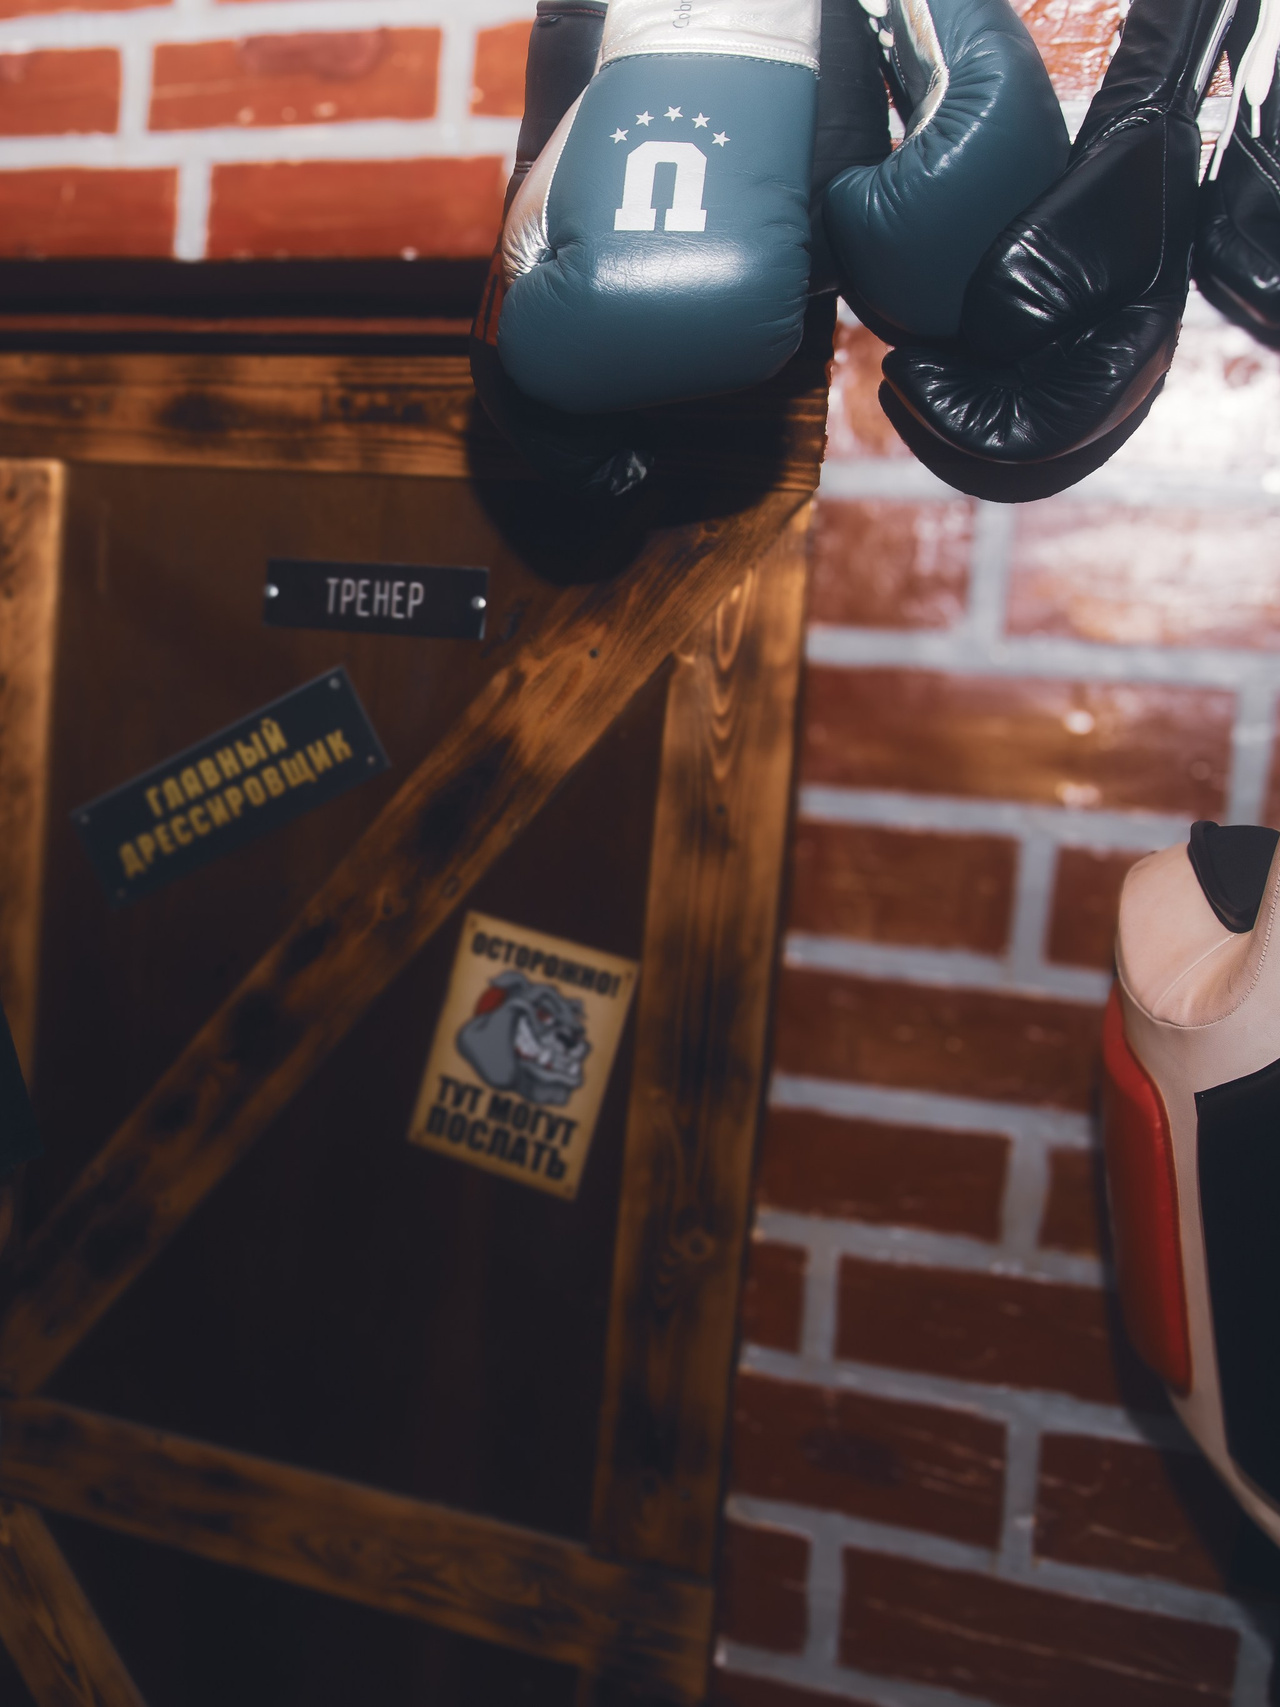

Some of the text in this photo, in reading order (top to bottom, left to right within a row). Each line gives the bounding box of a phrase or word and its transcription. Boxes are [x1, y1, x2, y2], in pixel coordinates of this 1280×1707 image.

[326, 577, 425, 619] ТРЕНЕР
[118, 729, 353, 880] ДРЕССИРОВЩИК
[145, 716, 288, 818] ГЛАВНЫЙ
[471, 932, 622, 998] ОСТОРОЖНО!
[426, 1106, 568, 1181] ПОСЛАТЬ
[438, 1073, 578, 1148] ТУТ МОГУТ
